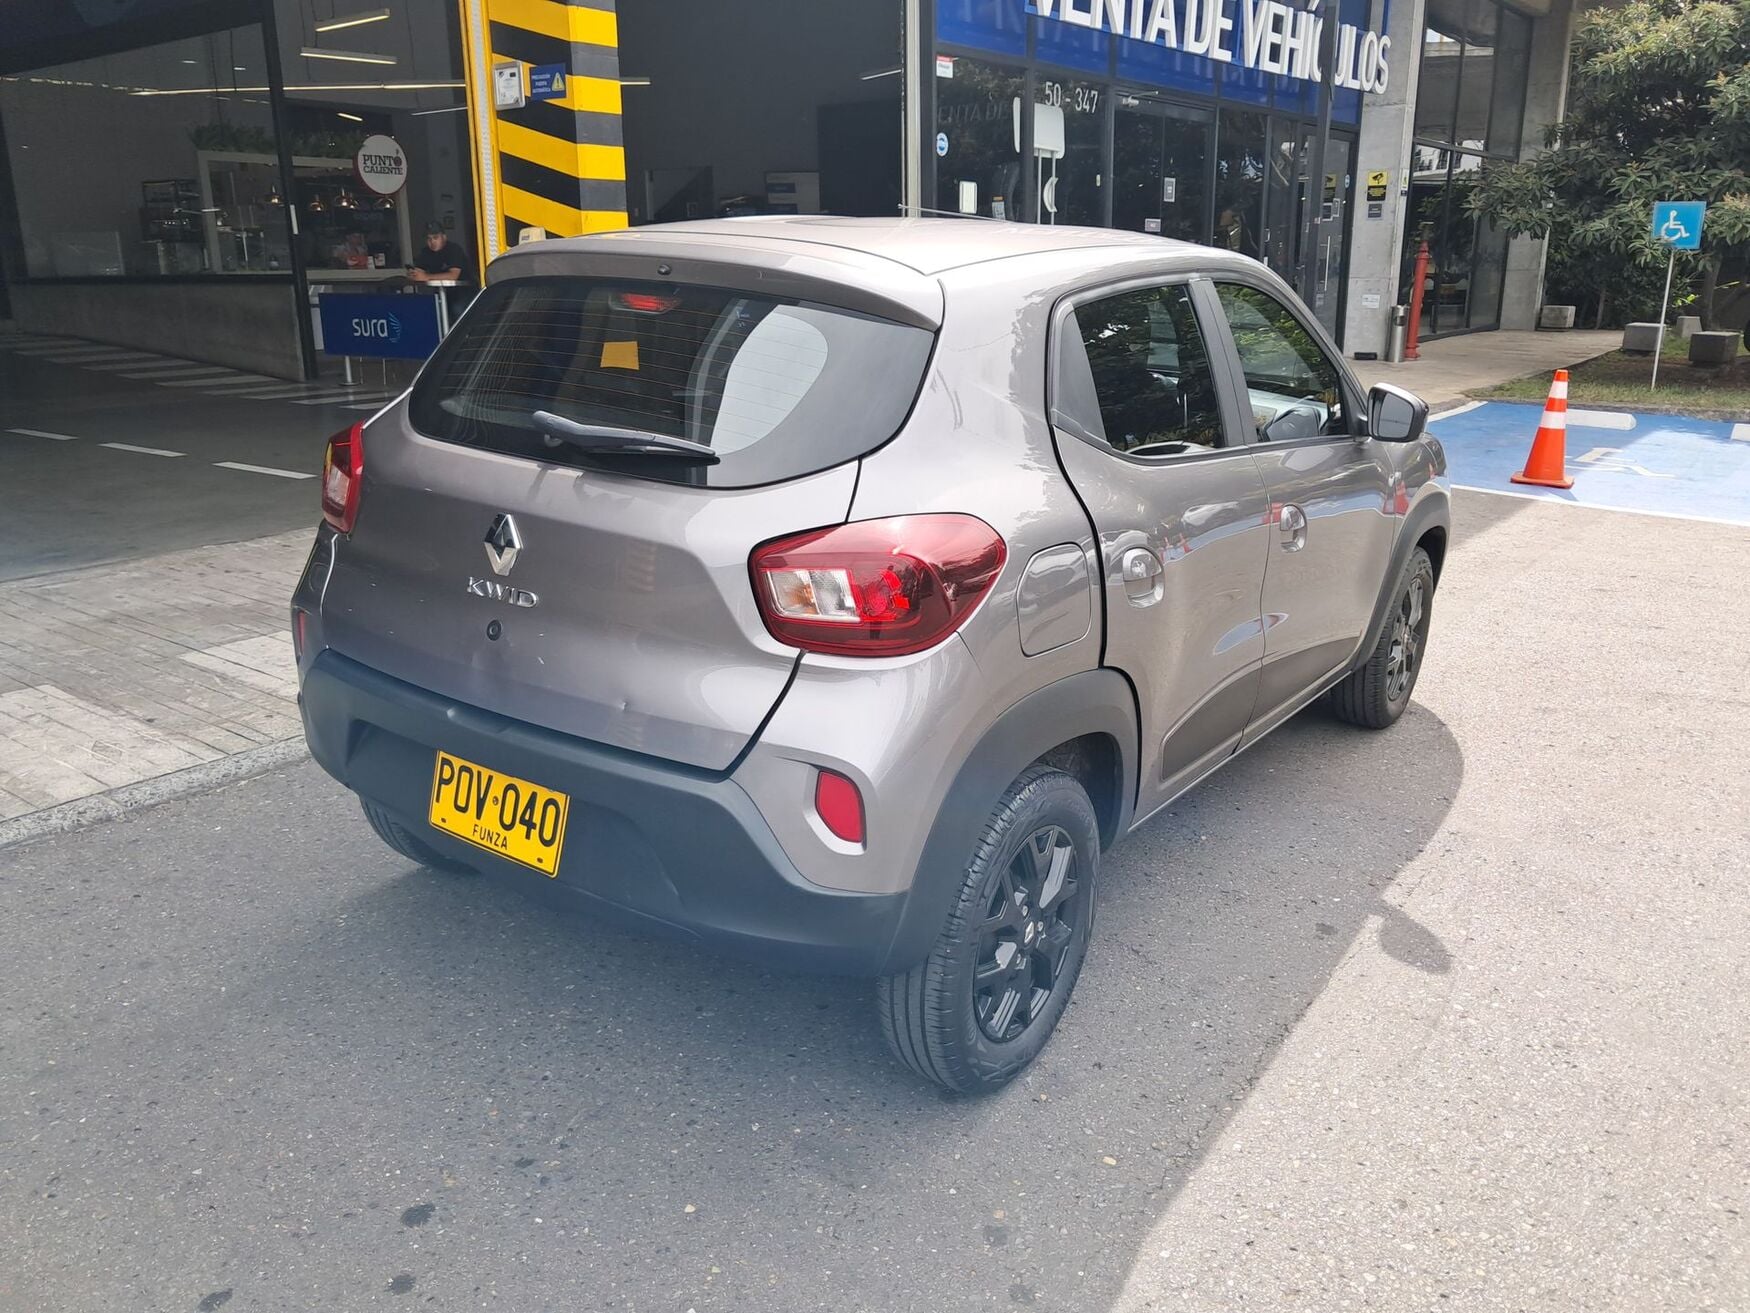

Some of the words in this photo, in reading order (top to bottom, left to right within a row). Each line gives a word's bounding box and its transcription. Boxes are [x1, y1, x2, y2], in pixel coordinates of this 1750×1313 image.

[1183, 0, 1233, 63] DE
[1045, 81, 1062, 107] 50
[1075, 87, 1099, 113] 347
[362, 154, 402, 167] PUNTO
[363, 165, 403, 176] CALIENTE
[352, 318, 389, 338] sura
[466, 576, 539, 608] KWID
[472, 823, 508, 850] FUNZA
